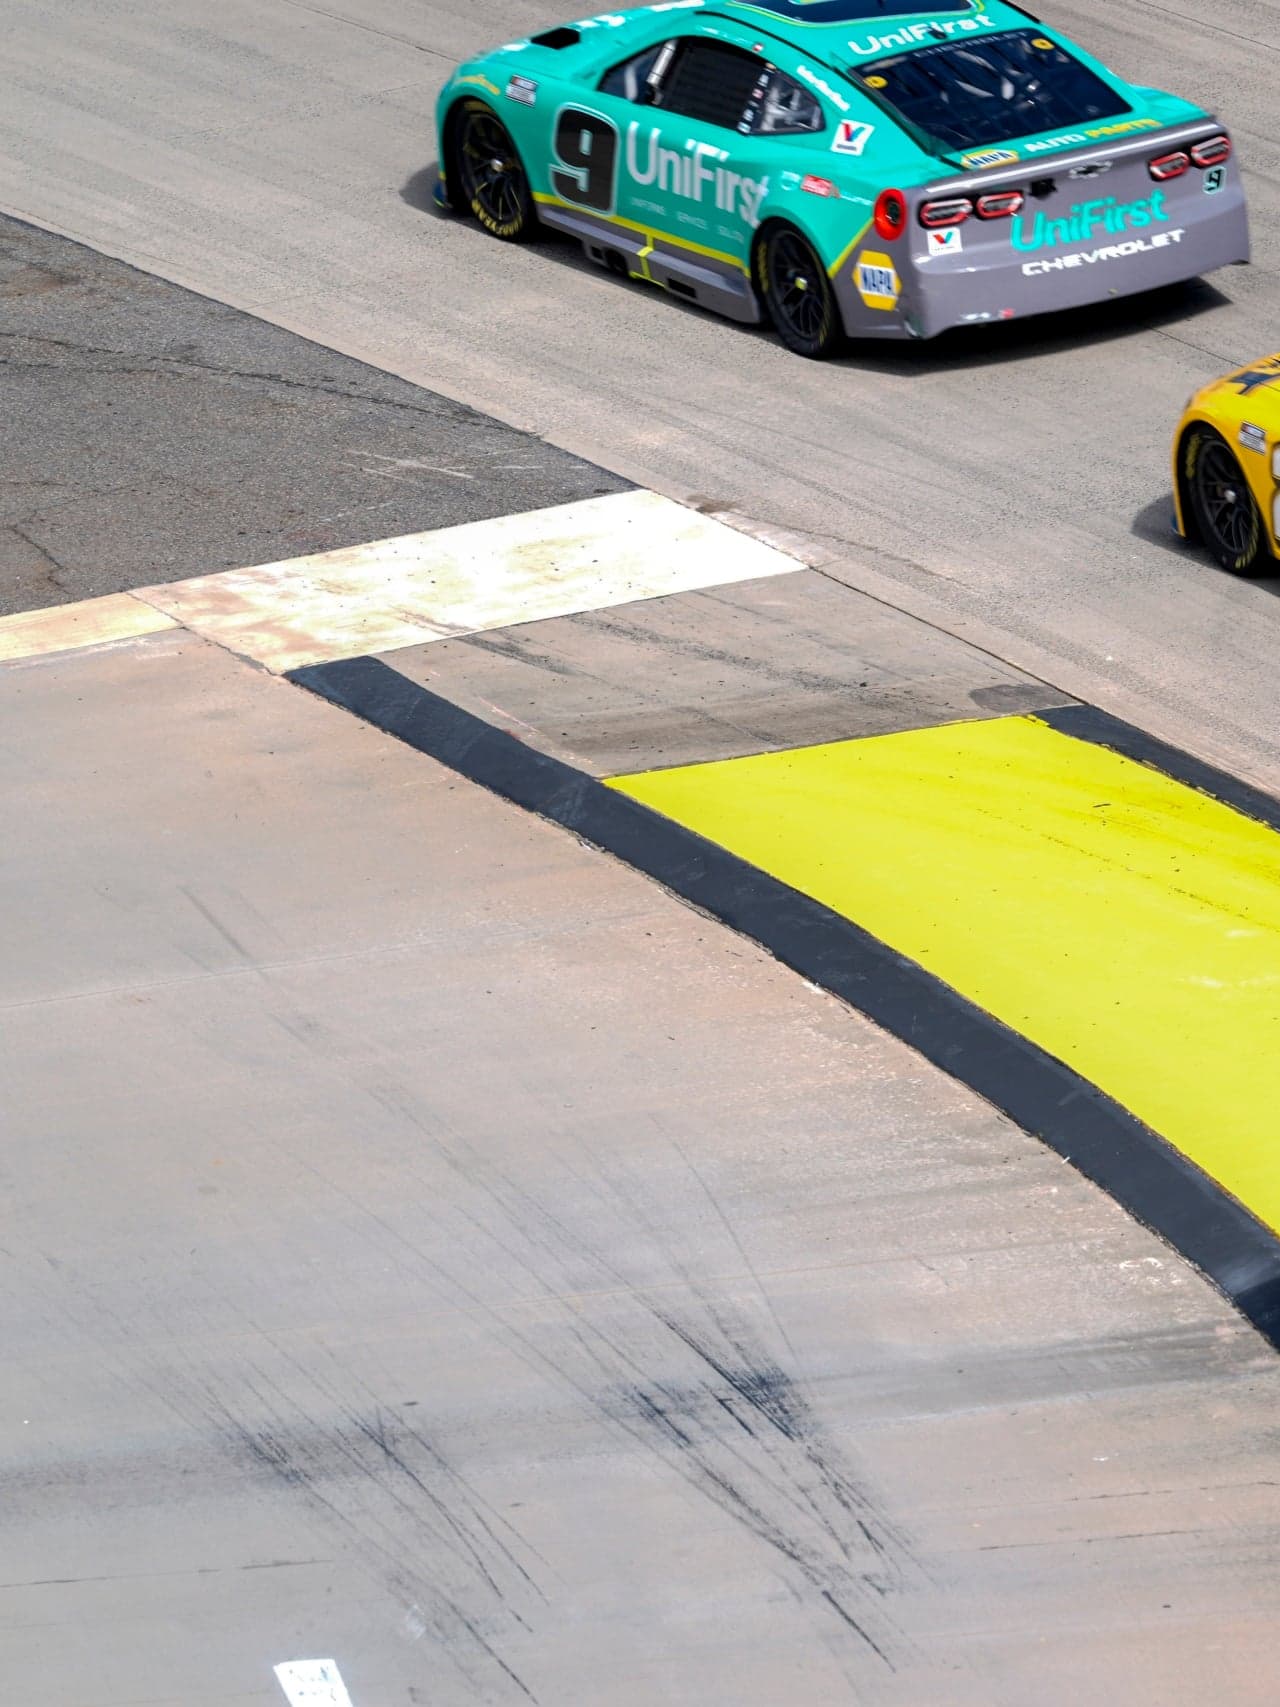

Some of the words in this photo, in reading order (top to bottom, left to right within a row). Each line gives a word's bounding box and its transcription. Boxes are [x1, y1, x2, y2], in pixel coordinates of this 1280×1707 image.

[848, 14, 997, 55] UniFirst
[549, 102, 619, 216] 9
[1024, 133, 1088, 152] AUTO
[626, 120, 769, 229] UniFirst
[1011, 188, 1169, 251] UniFirst
[1022, 228, 1185, 276] CHEVROLET
